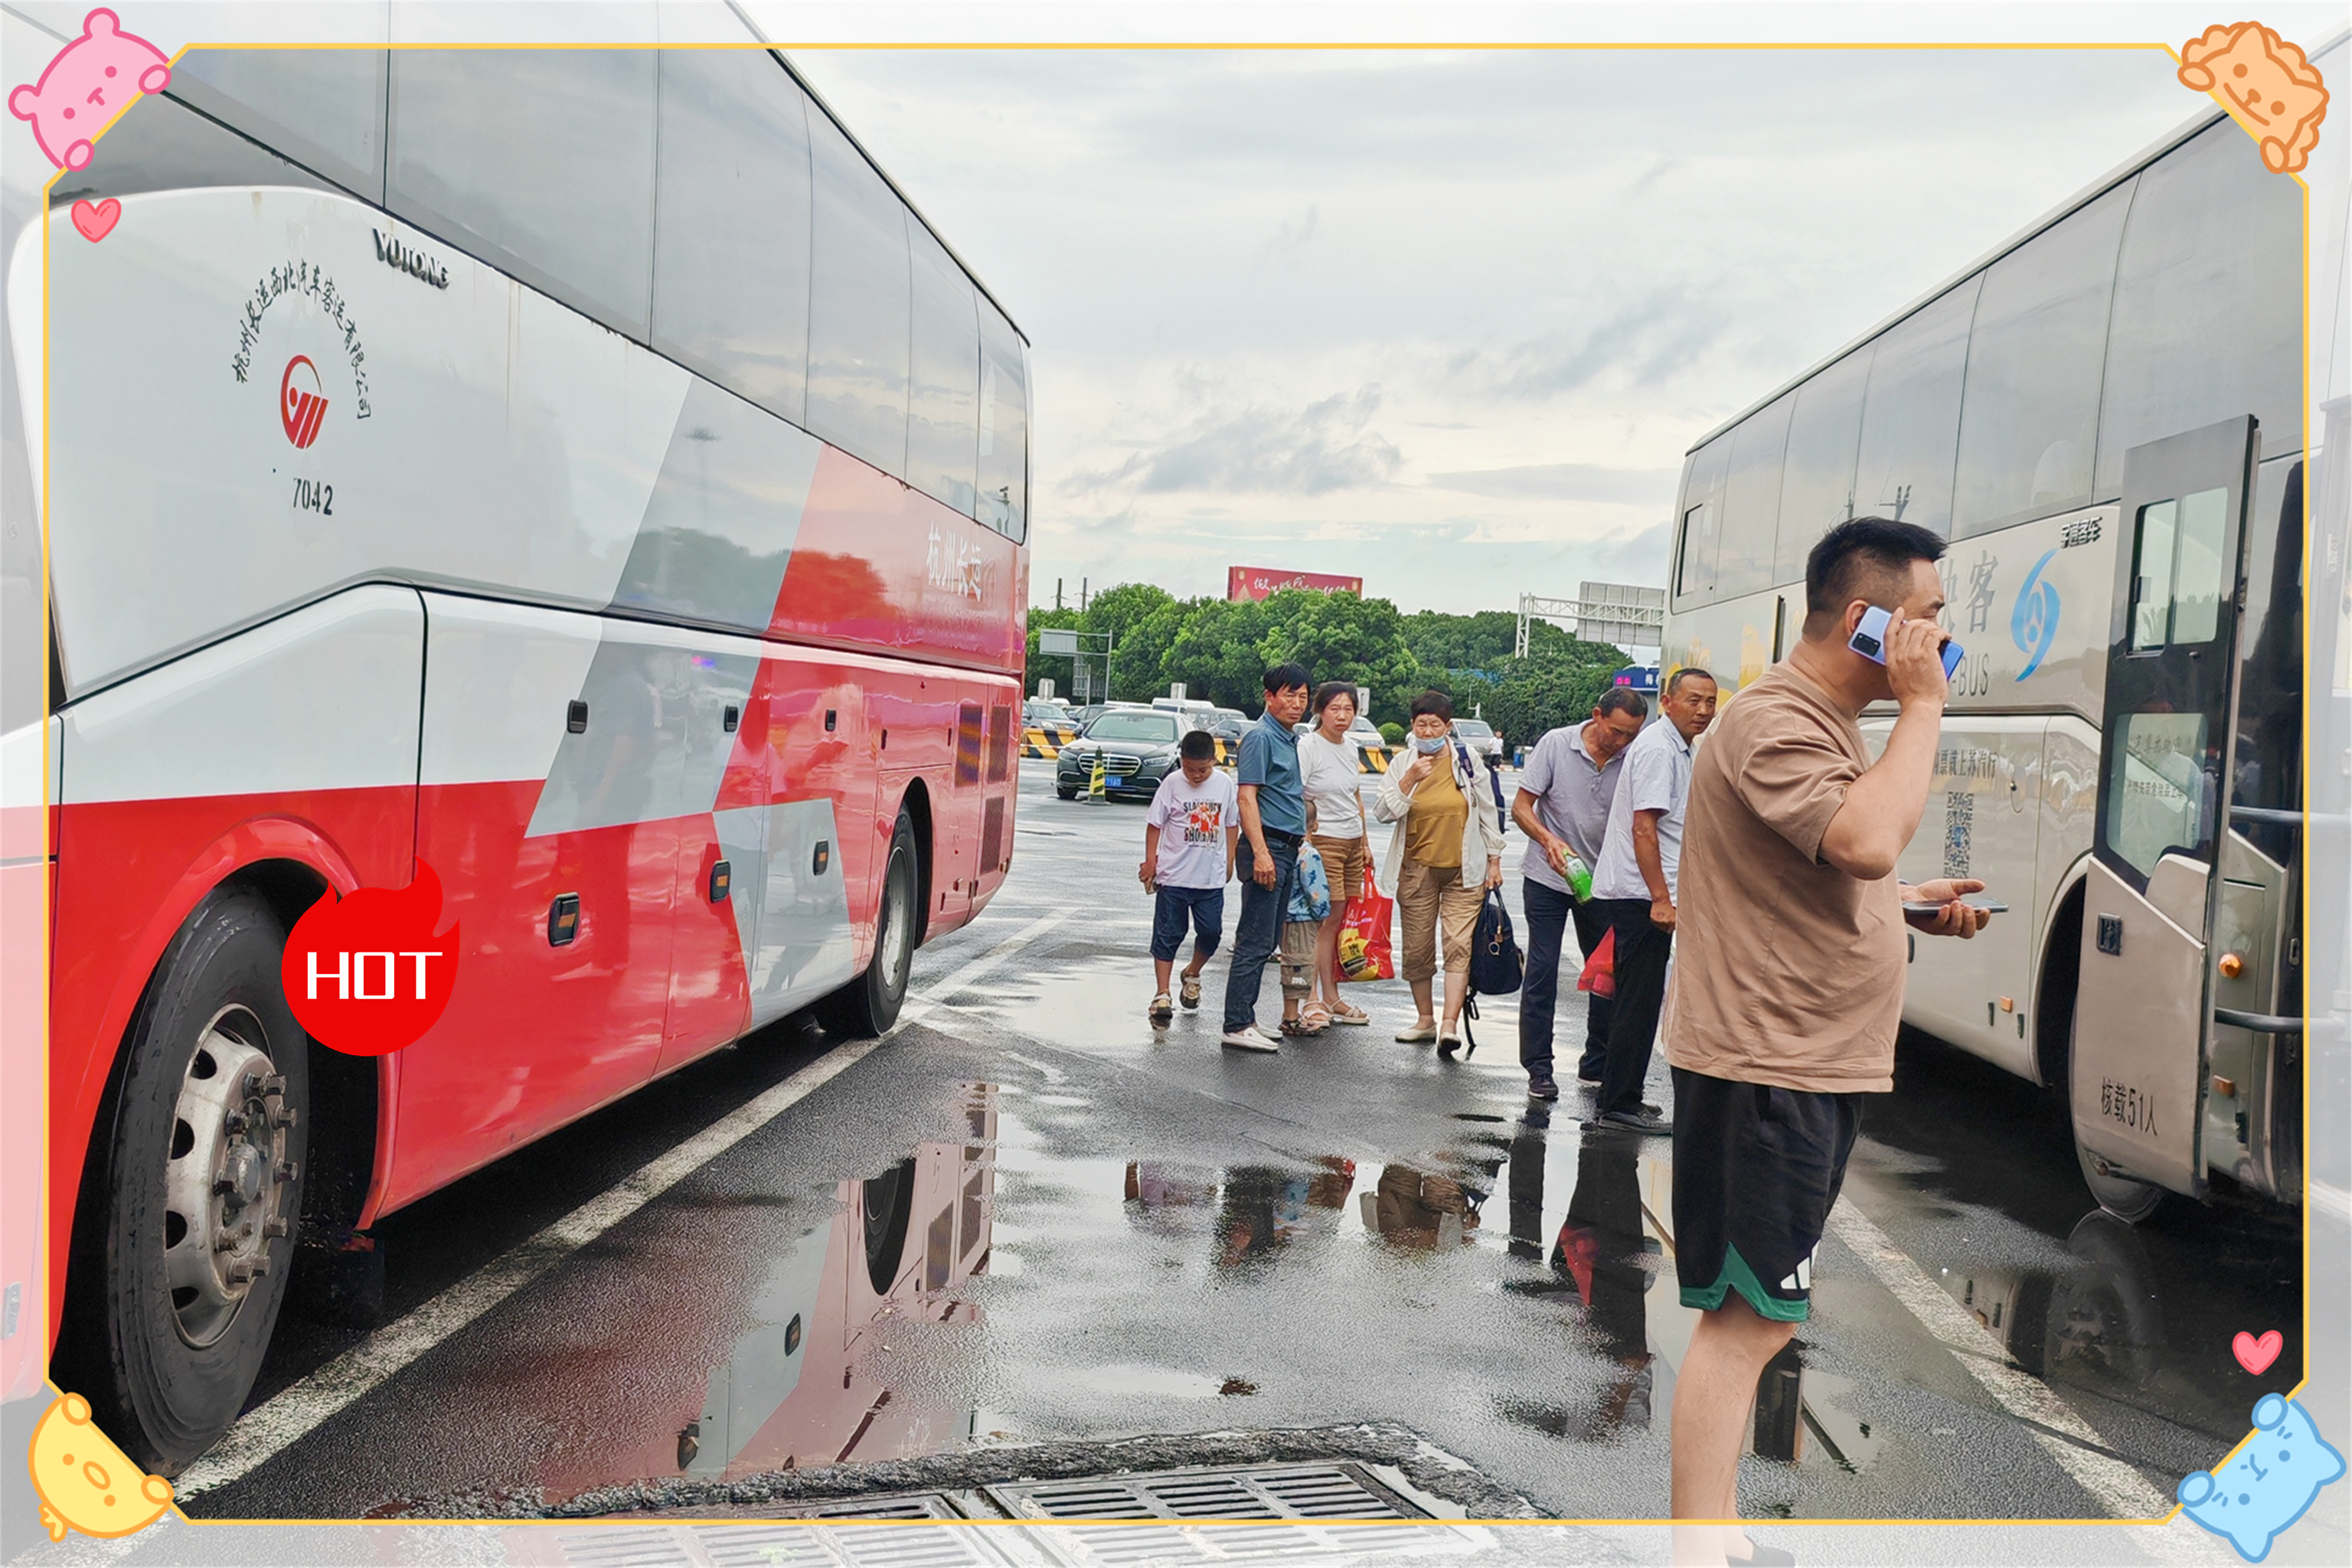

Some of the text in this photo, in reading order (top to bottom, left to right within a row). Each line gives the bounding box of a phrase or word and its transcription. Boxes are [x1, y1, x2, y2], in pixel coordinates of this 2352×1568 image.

[293, 478, 333, 516] 7042
[2101, 1076, 2158, 1136] 核载51人
